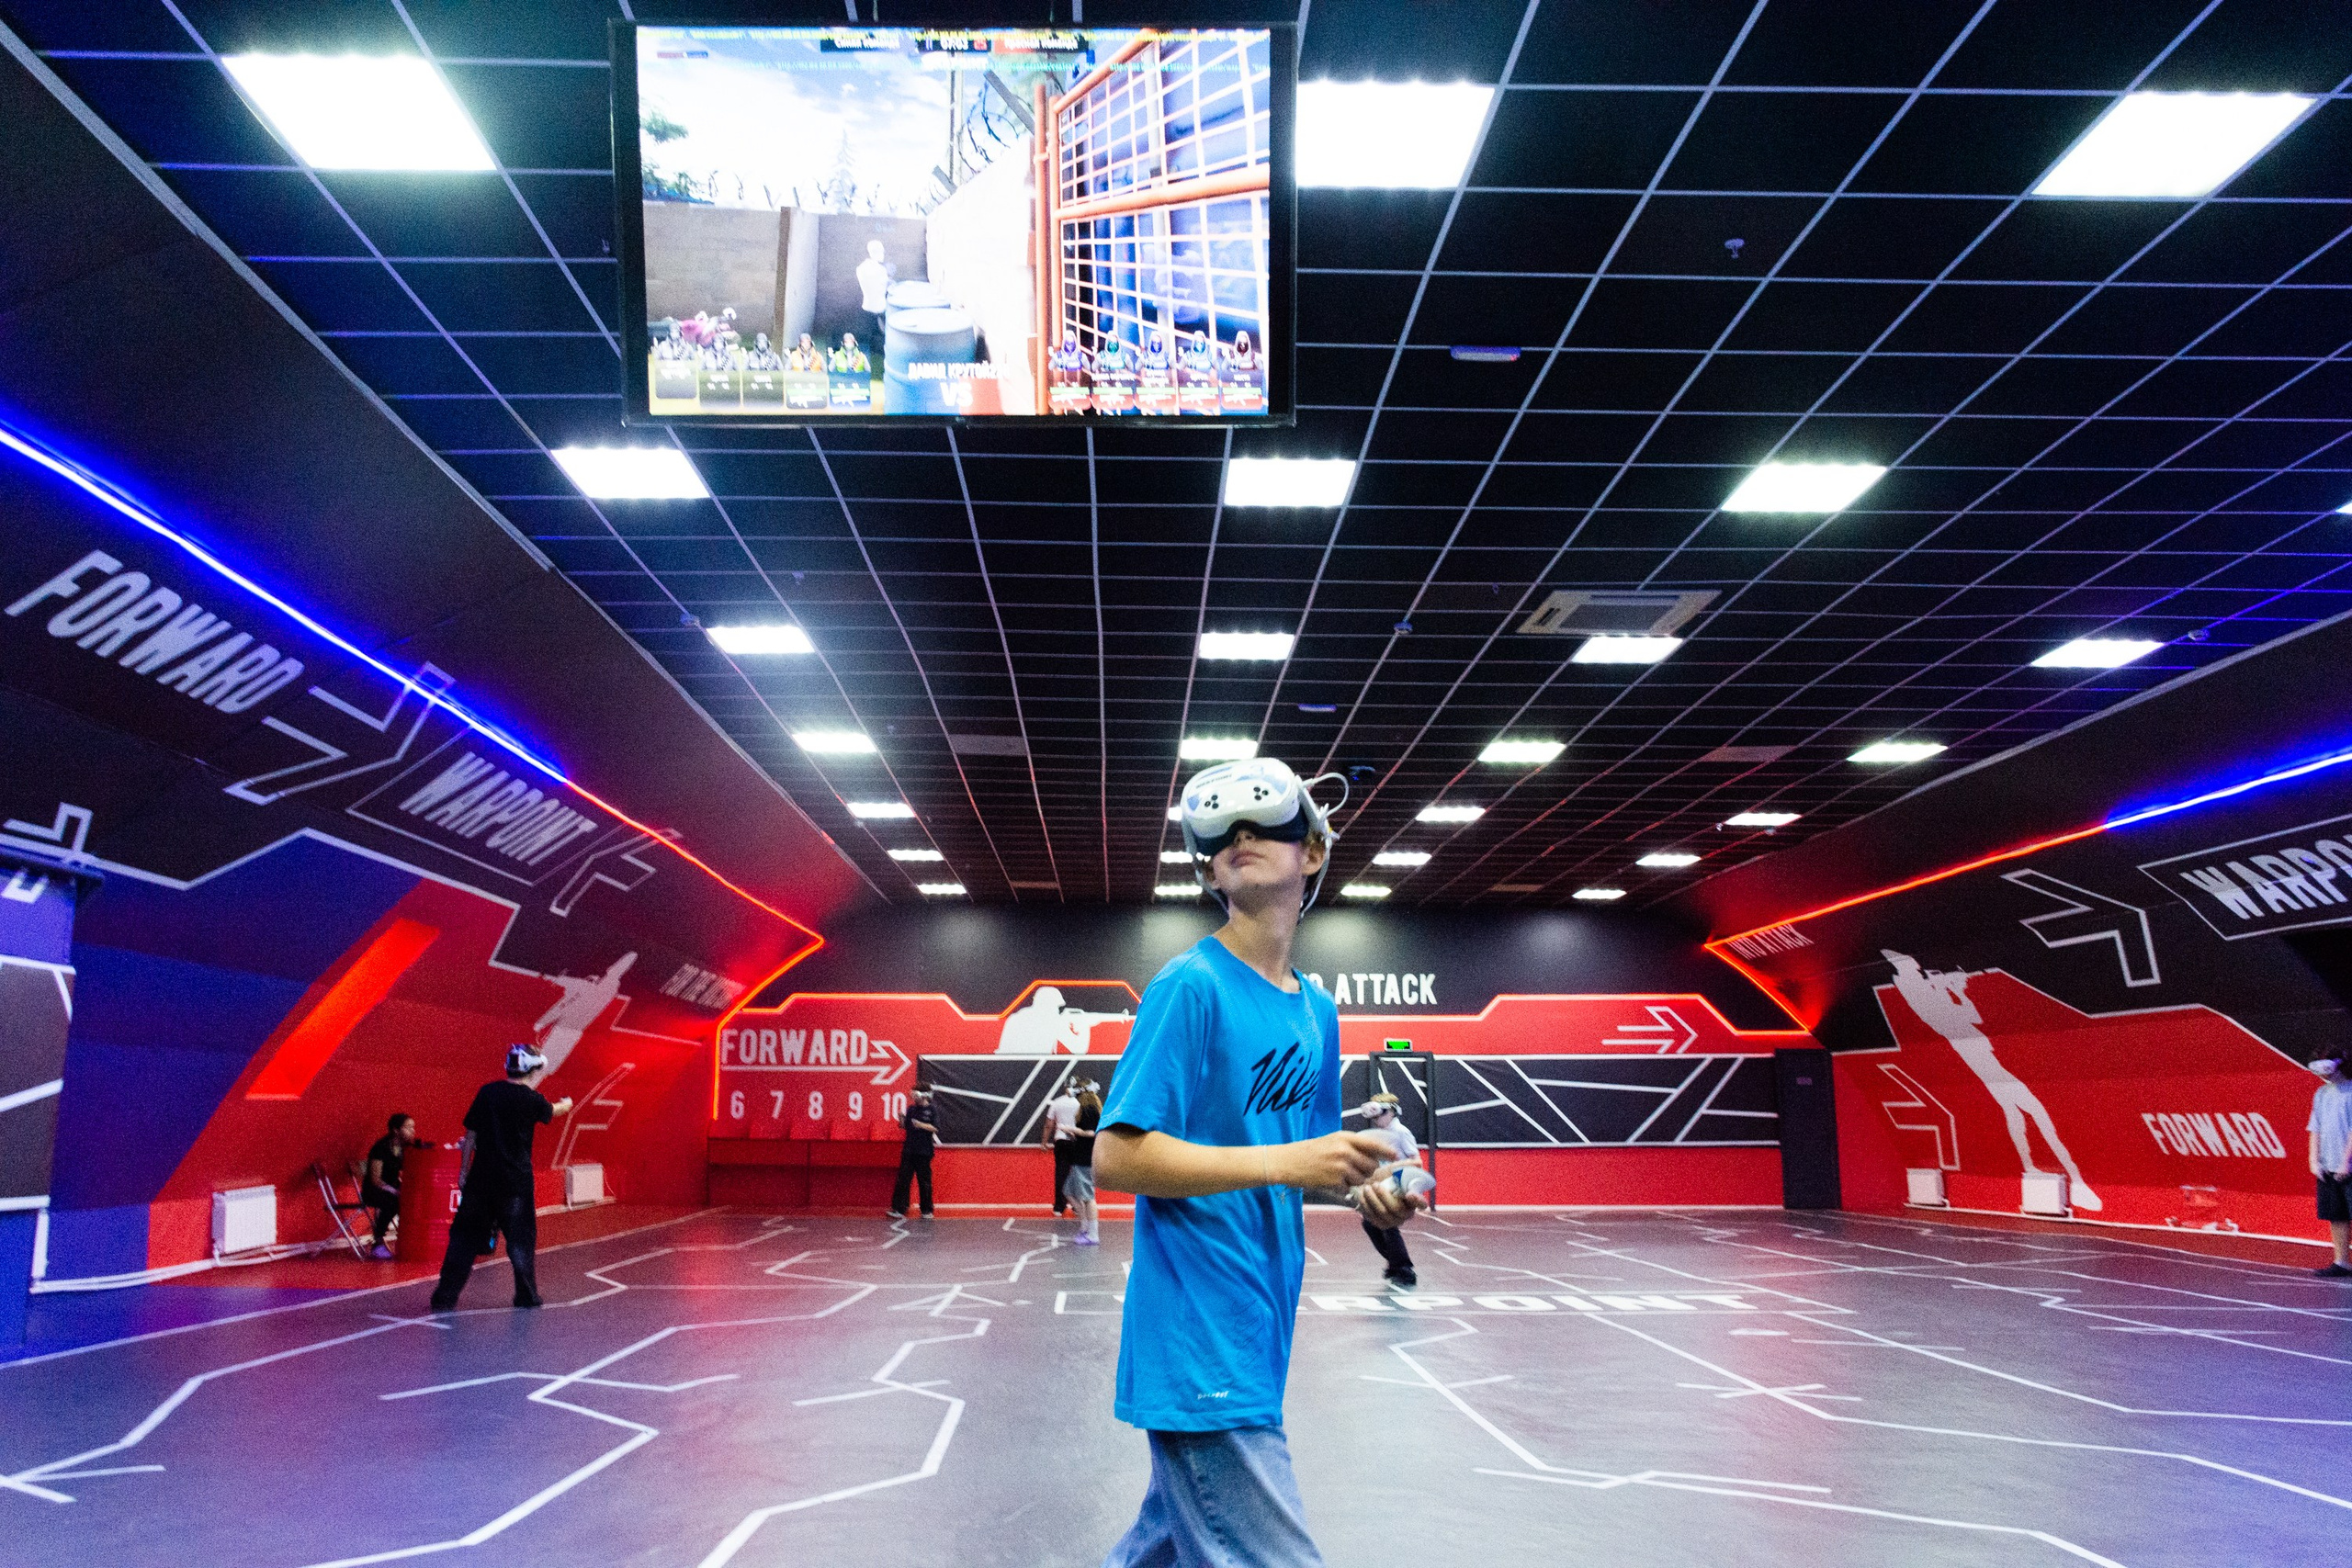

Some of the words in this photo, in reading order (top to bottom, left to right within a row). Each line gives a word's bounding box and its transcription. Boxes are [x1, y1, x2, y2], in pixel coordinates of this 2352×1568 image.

[4, 549, 305, 714] FORWARD
[398, 750, 599, 866] WARPOINT
[2178, 834, 2352, 919] WARPO
[1727, 936, 1767, 960] INTO
[1753, 923, 1815, 954] ATTACK
[1335, 973, 1438, 1005] ATTACK
[721, 1029, 868, 1065] FORWARD
[729, 1090, 745, 1120] 6
[770, 1090, 784, 1120] 7
[808, 1090, 823, 1121] 8
[848, 1091, 864, 1121] 9
[881, 1091, 908, 1122] 10
[2141, 1111, 2287, 1158] FORWARD
[1113, 1295, 1758, 1311] RPOINT
